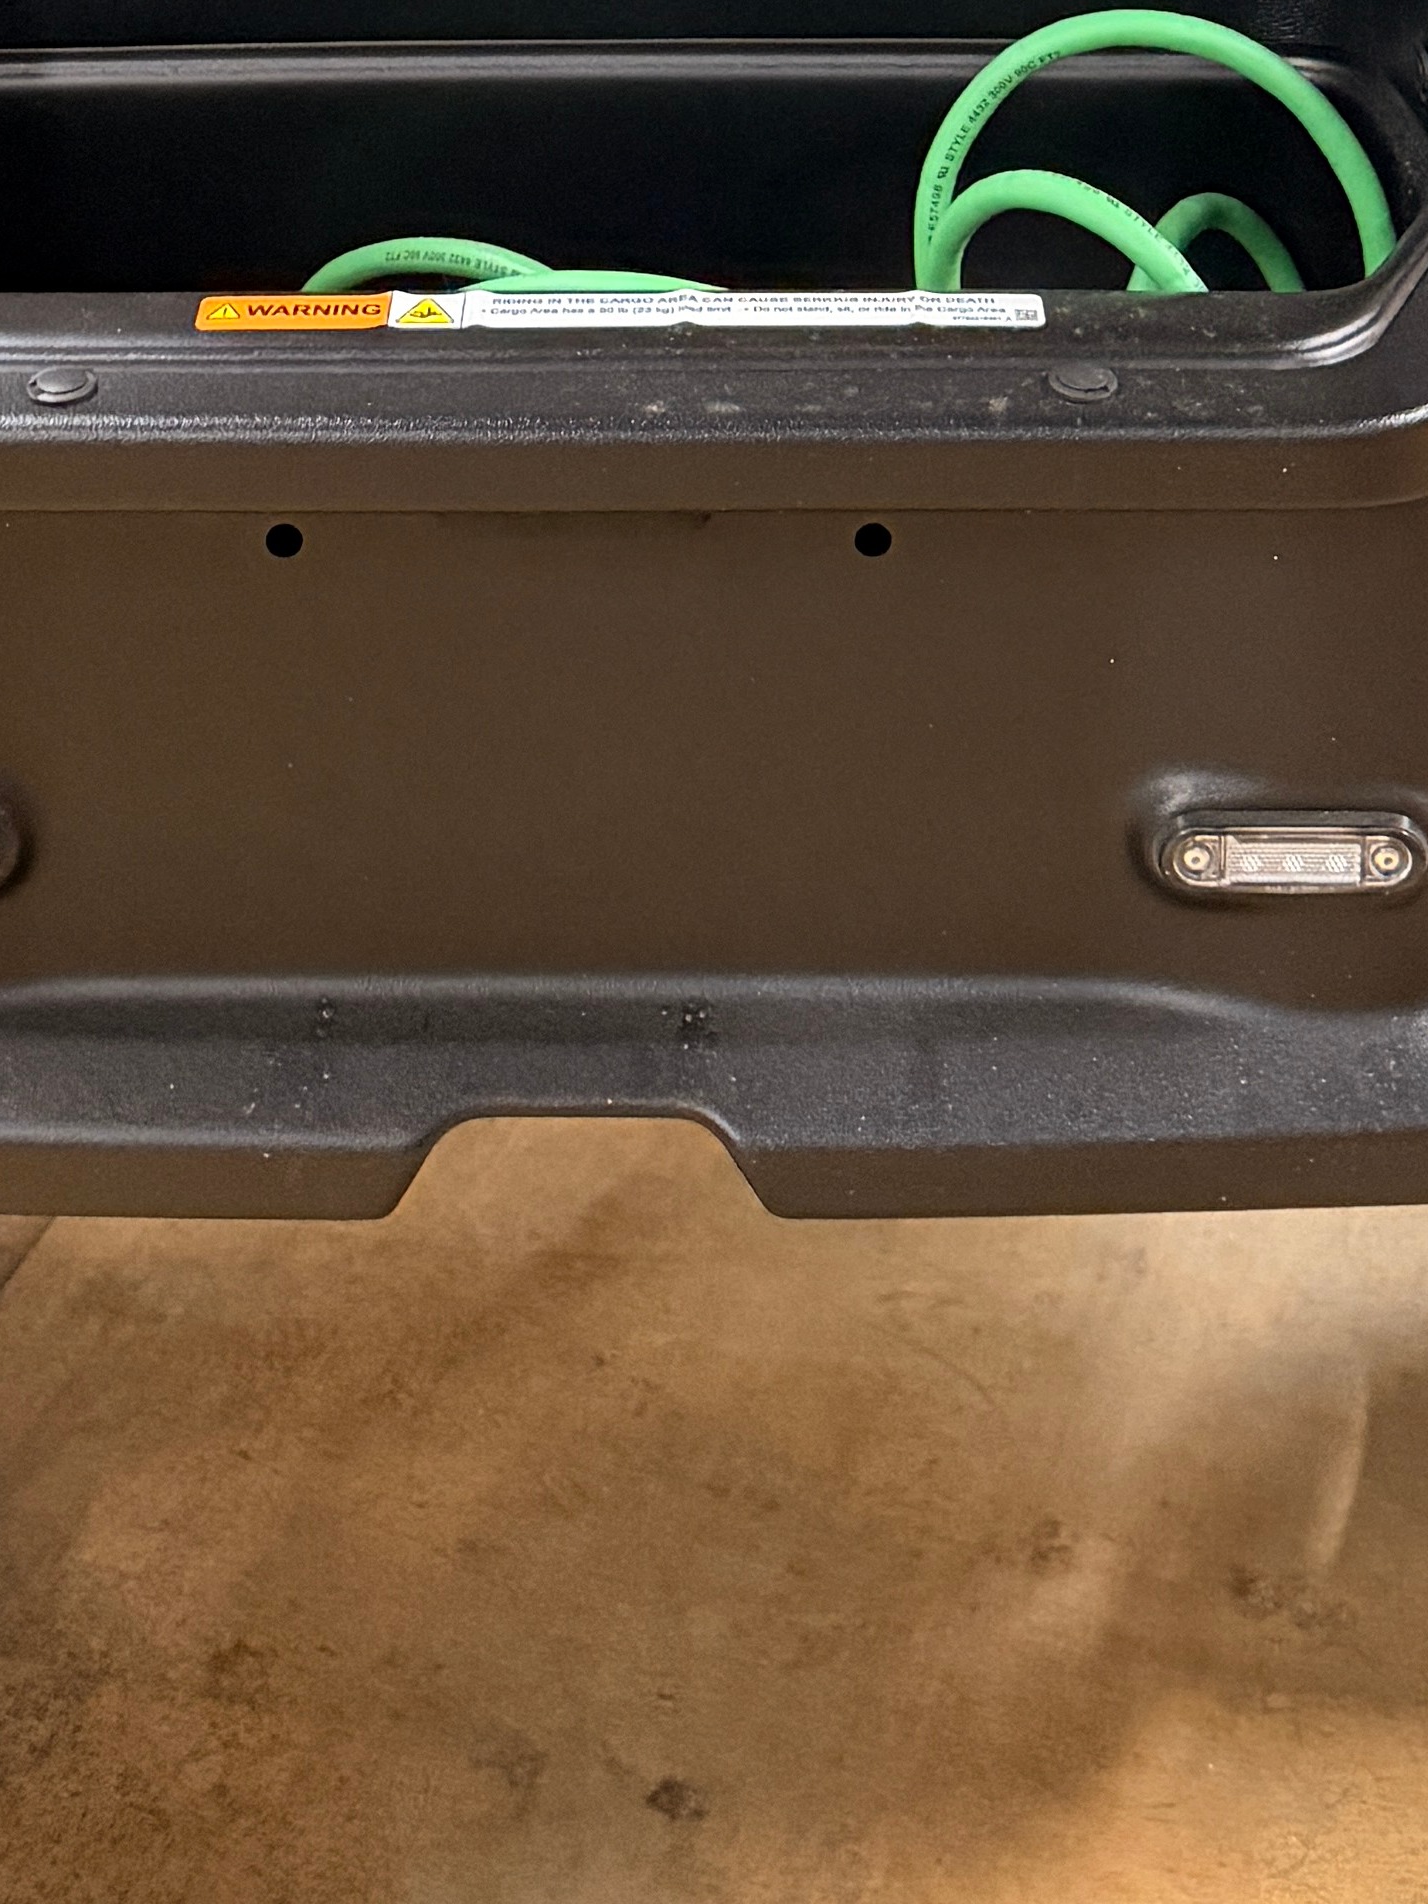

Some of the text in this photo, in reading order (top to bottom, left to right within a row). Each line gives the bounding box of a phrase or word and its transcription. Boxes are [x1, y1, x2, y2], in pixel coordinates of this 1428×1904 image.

[945, 125, 969, 162] STYLE
[548, 297, 562, 305] IN
[567, 297, 595, 305] THE
[657, 294, 698, 303] AREA
[248, 303, 382, 316] WARNING
[490, 307, 527, 315] Cargo
[937, 306, 974, 315] Cargo
